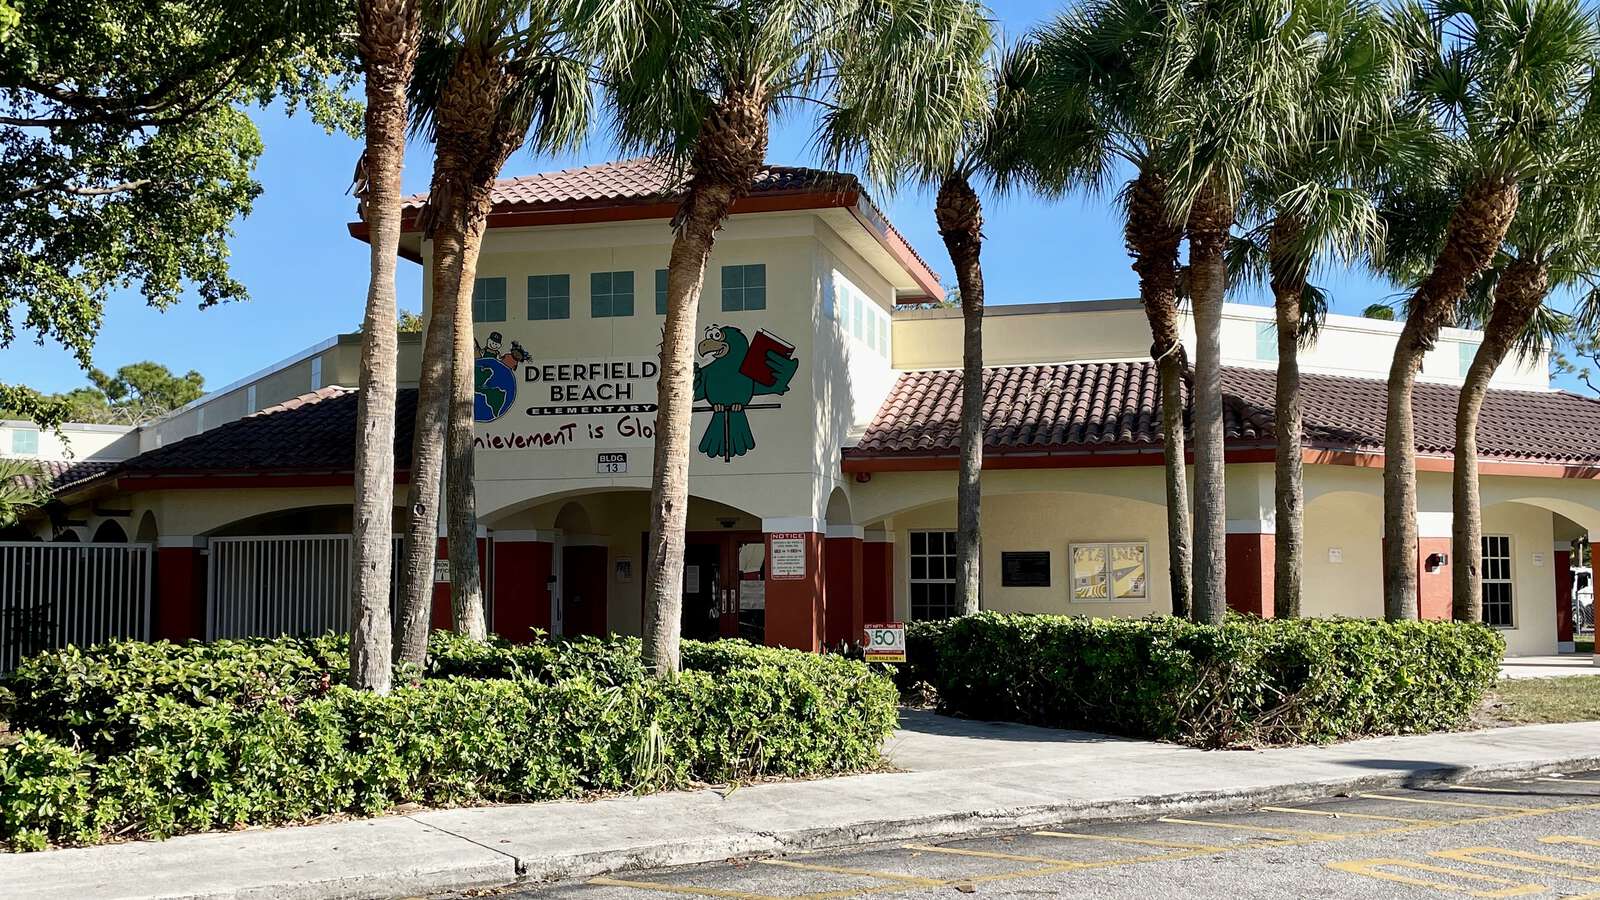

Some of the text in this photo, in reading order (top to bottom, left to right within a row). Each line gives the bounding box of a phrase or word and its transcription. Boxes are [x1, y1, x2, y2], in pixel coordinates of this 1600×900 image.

[524, 361, 658, 382] DEERFIELD
[550, 382, 632, 401] BEACH
[531, 404, 653, 415] ELEMENTARY
[587, 423, 605, 439] is
[599, 454, 625, 462] BLDG.
[606, 463, 619, 473] 13
[875, 630, 895, 646] 50
